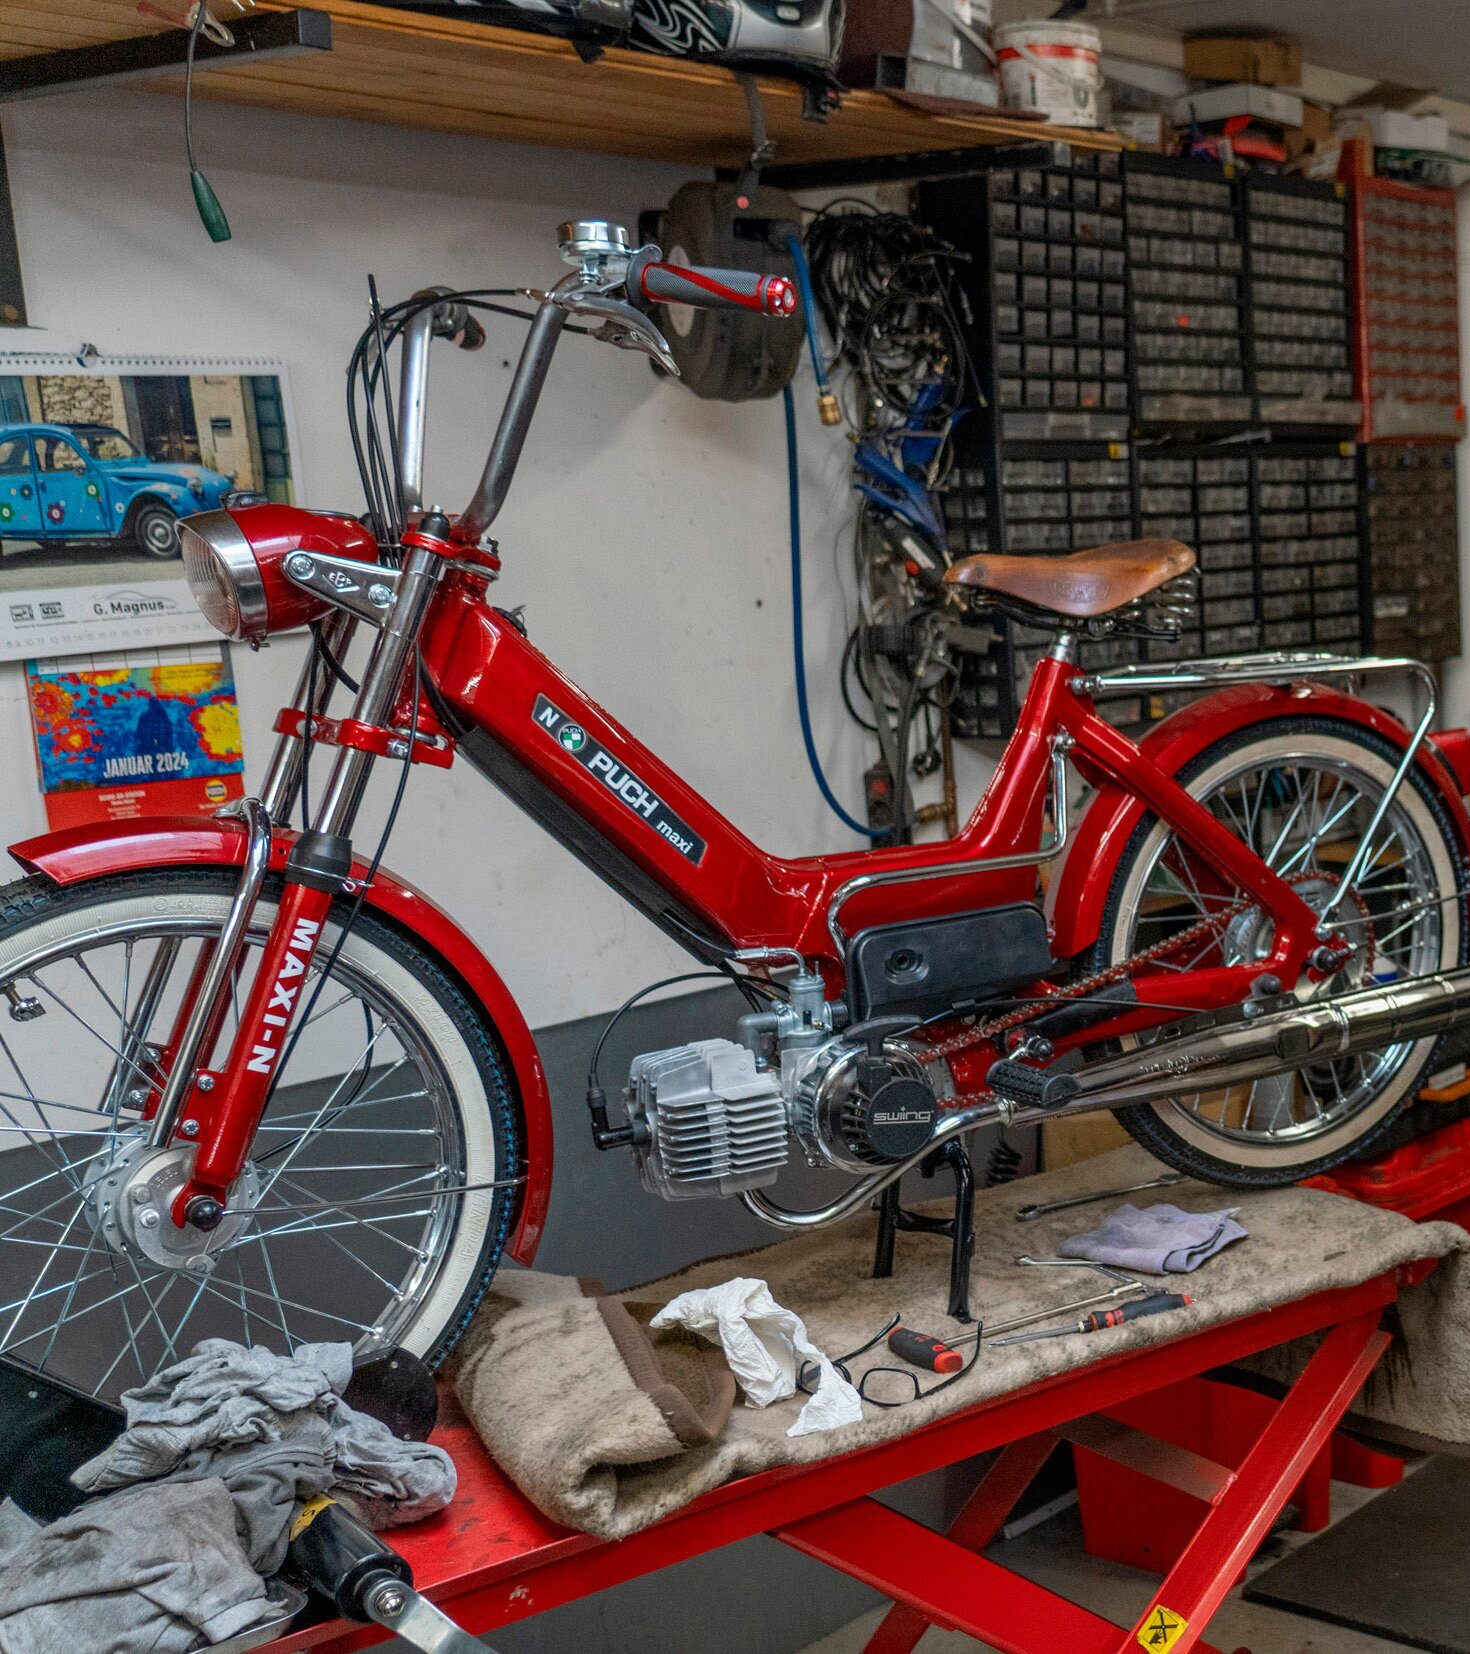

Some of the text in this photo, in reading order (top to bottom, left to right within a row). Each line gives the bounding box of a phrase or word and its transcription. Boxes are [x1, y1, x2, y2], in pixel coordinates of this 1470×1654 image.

[110, 602, 164, 615] Magnus
[103, 752, 189, 778] JANUAR 2024
[539, 707, 693, 854] N PUCH maxi
[247, 918, 320, 1074] MAXI-N
